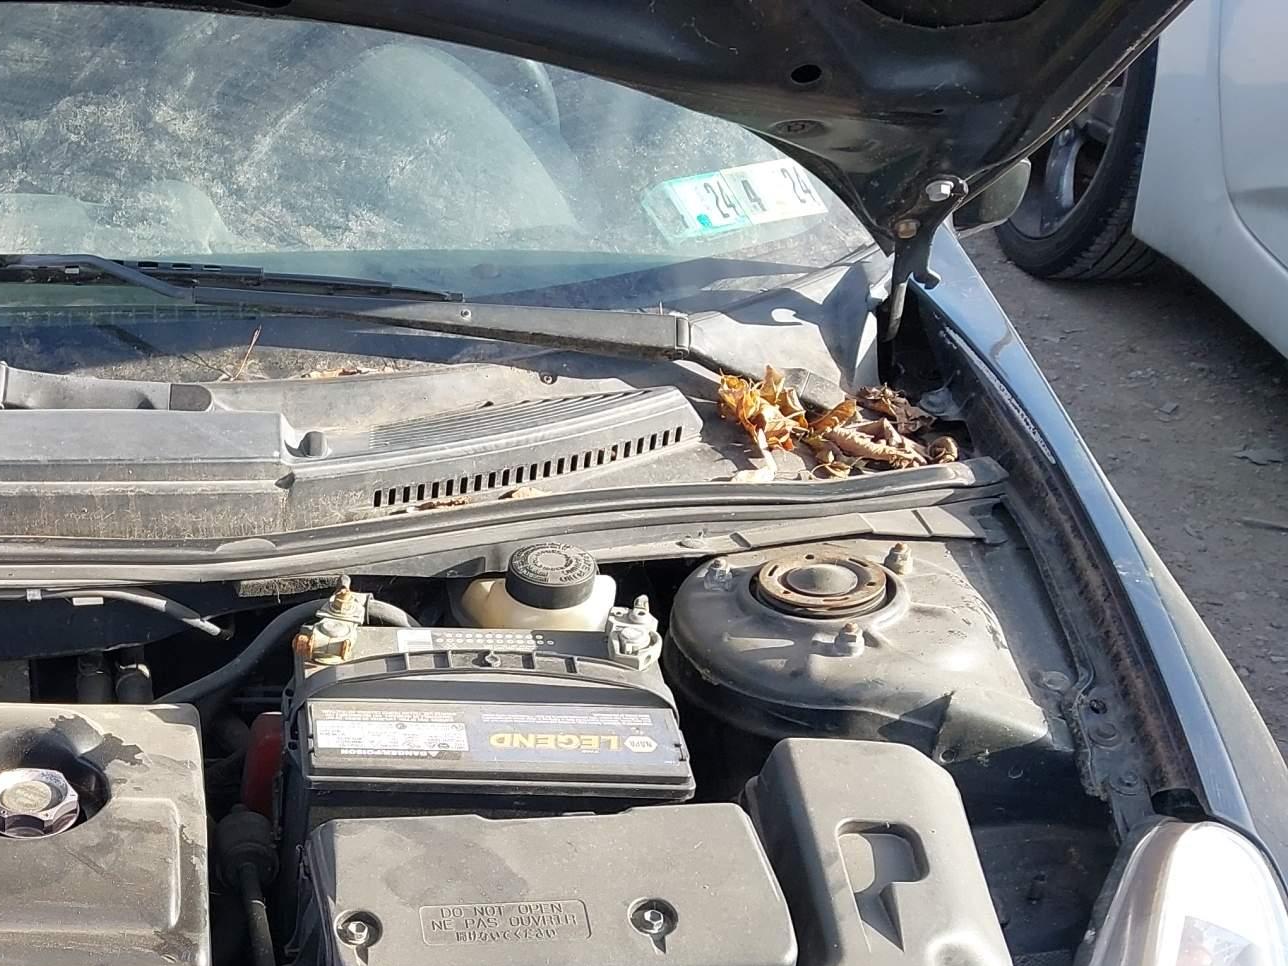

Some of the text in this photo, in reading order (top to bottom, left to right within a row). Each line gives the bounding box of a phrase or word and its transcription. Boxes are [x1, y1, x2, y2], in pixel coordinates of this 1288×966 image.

[489, 733, 620, 750] LEGEND
[440, 903, 563, 919] DO NOT OPEN
[431, 913, 578, 932] NE PAS OUVRIR
